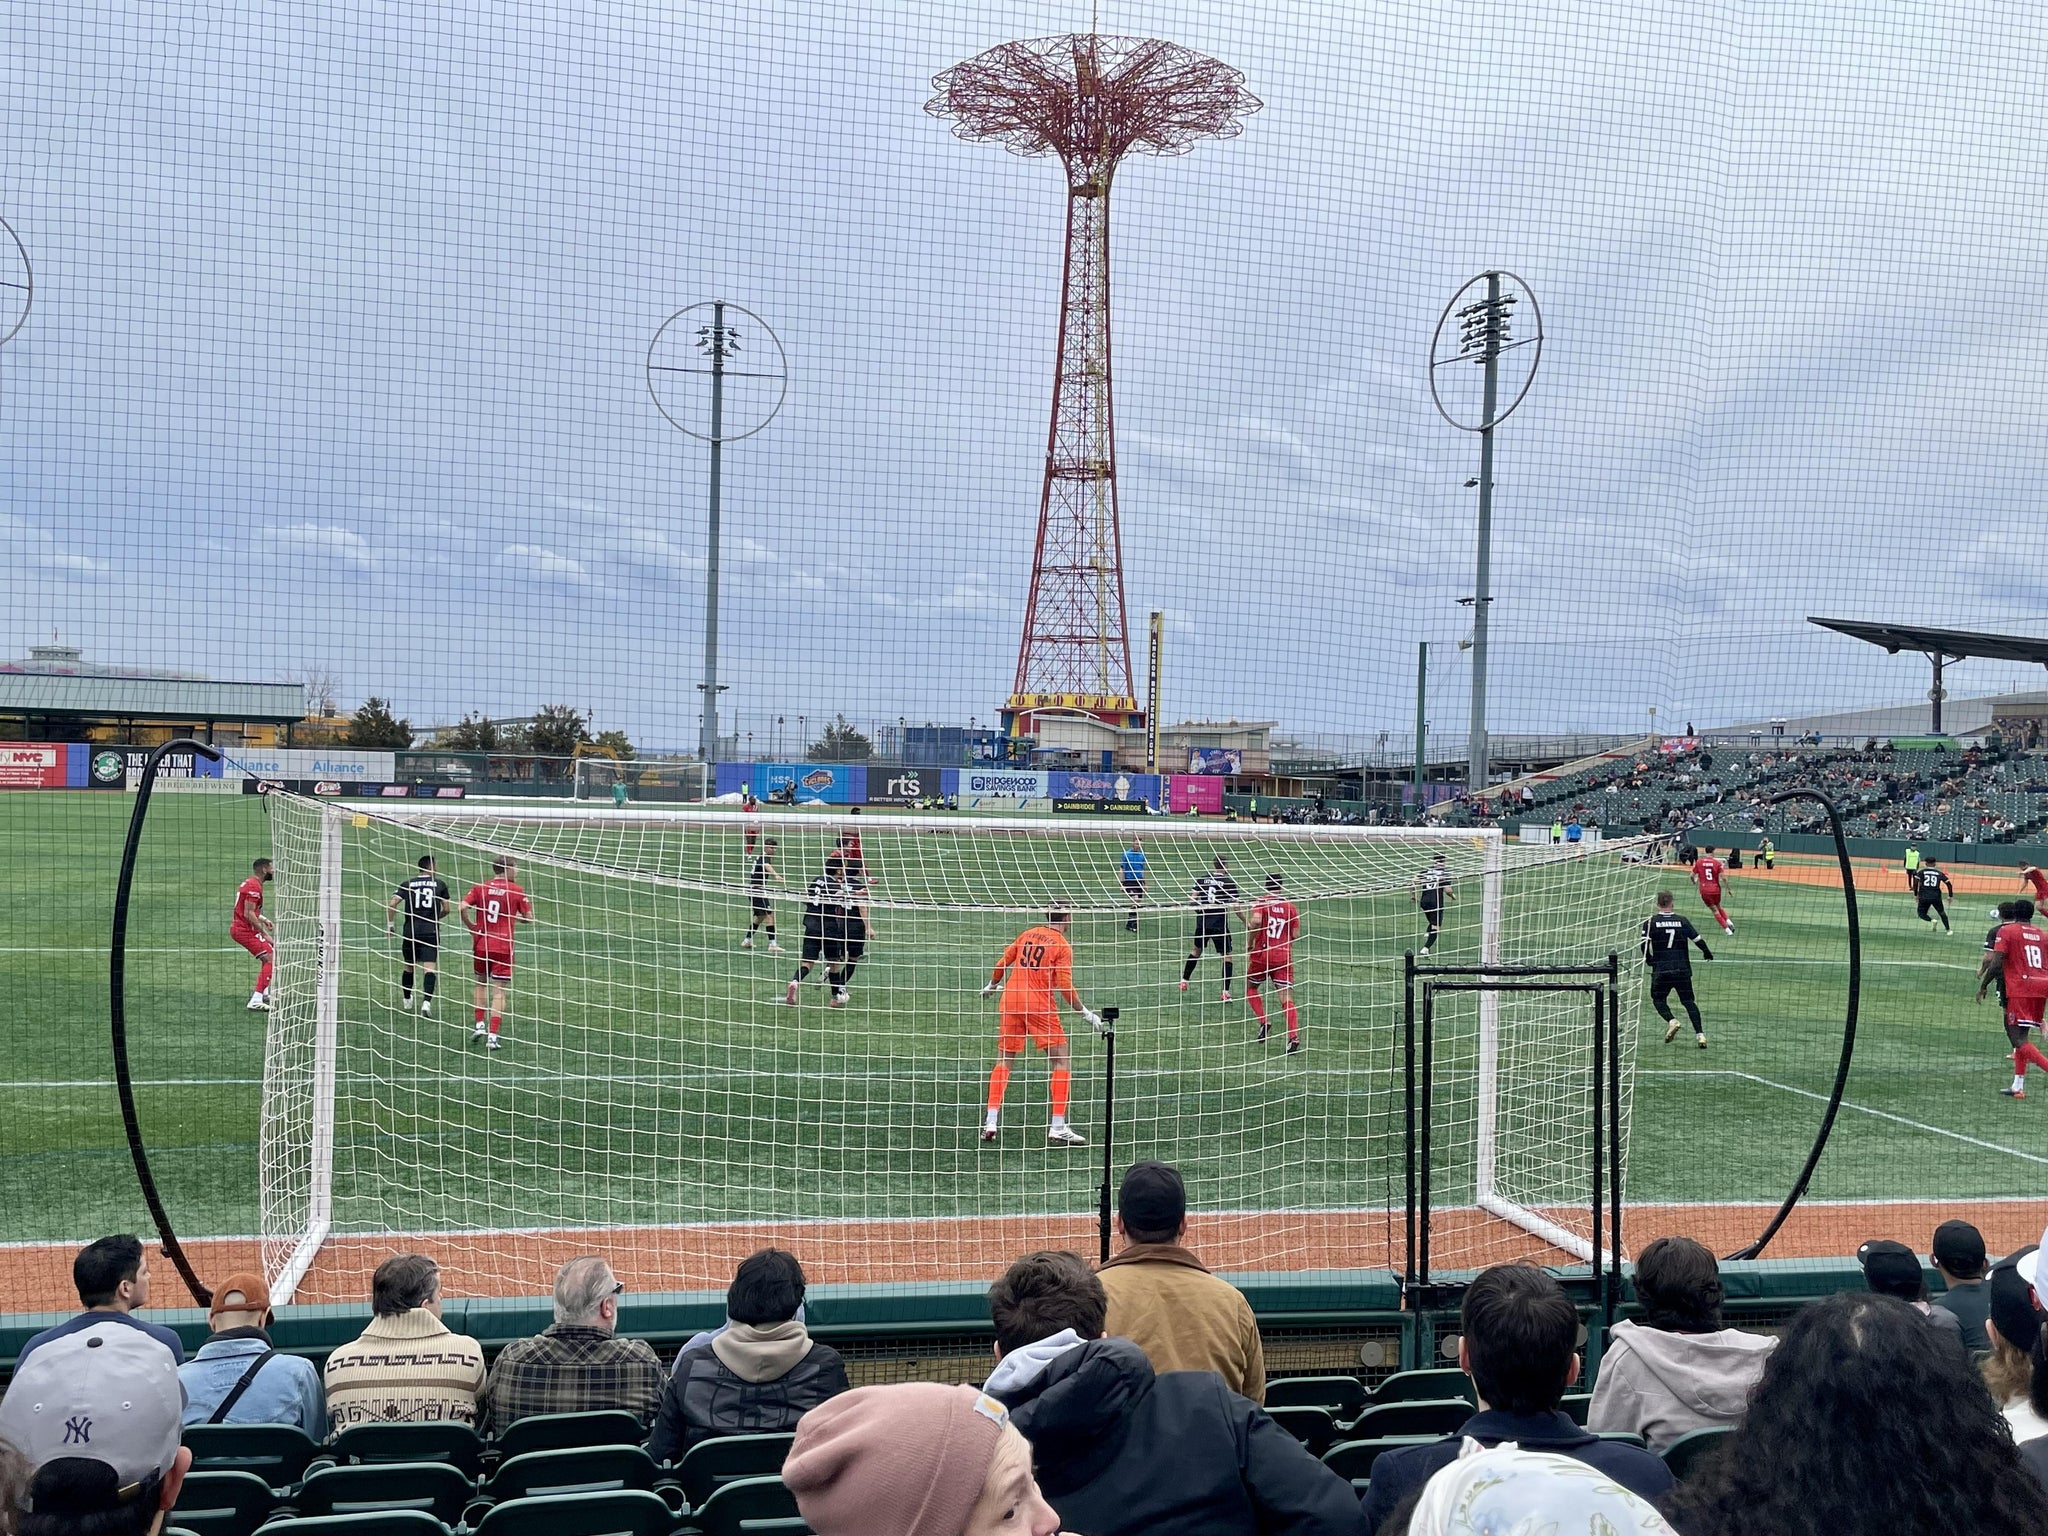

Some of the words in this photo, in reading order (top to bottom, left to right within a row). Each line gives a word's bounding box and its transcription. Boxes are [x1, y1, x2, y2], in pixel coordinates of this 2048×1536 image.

[13, 752, 43, 763] NYC
[127, 753, 143, 767] THE
[172, 754, 193, 768] THAT
[225, 758, 280, 771] Alliance
[312, 759, 365, 773] Alliance
[192, 782, 235, 790] BREWING
[887, 775, 921, 796] rts
[985, 776, 1037, 786] RIDGEWOOD
[1063, 803, 1096, 811] GAINBRIDGE
[1109, 804, 1142, 812] GAINBRIDGE
[1705, 868, 1713, 881] 5
[1923, 874, 1938, 887] 29
[414, 887, 434, 909] 13
[486, 900, 500, 924] 9
[1267, 916, 1286, 940] 37
[1665, 928, 1676, 949] 7
[1020, 941, 1046, 971] 99
[2023, 944, 2043, 969] 18
[63, 1415, 93, 1444] NY
